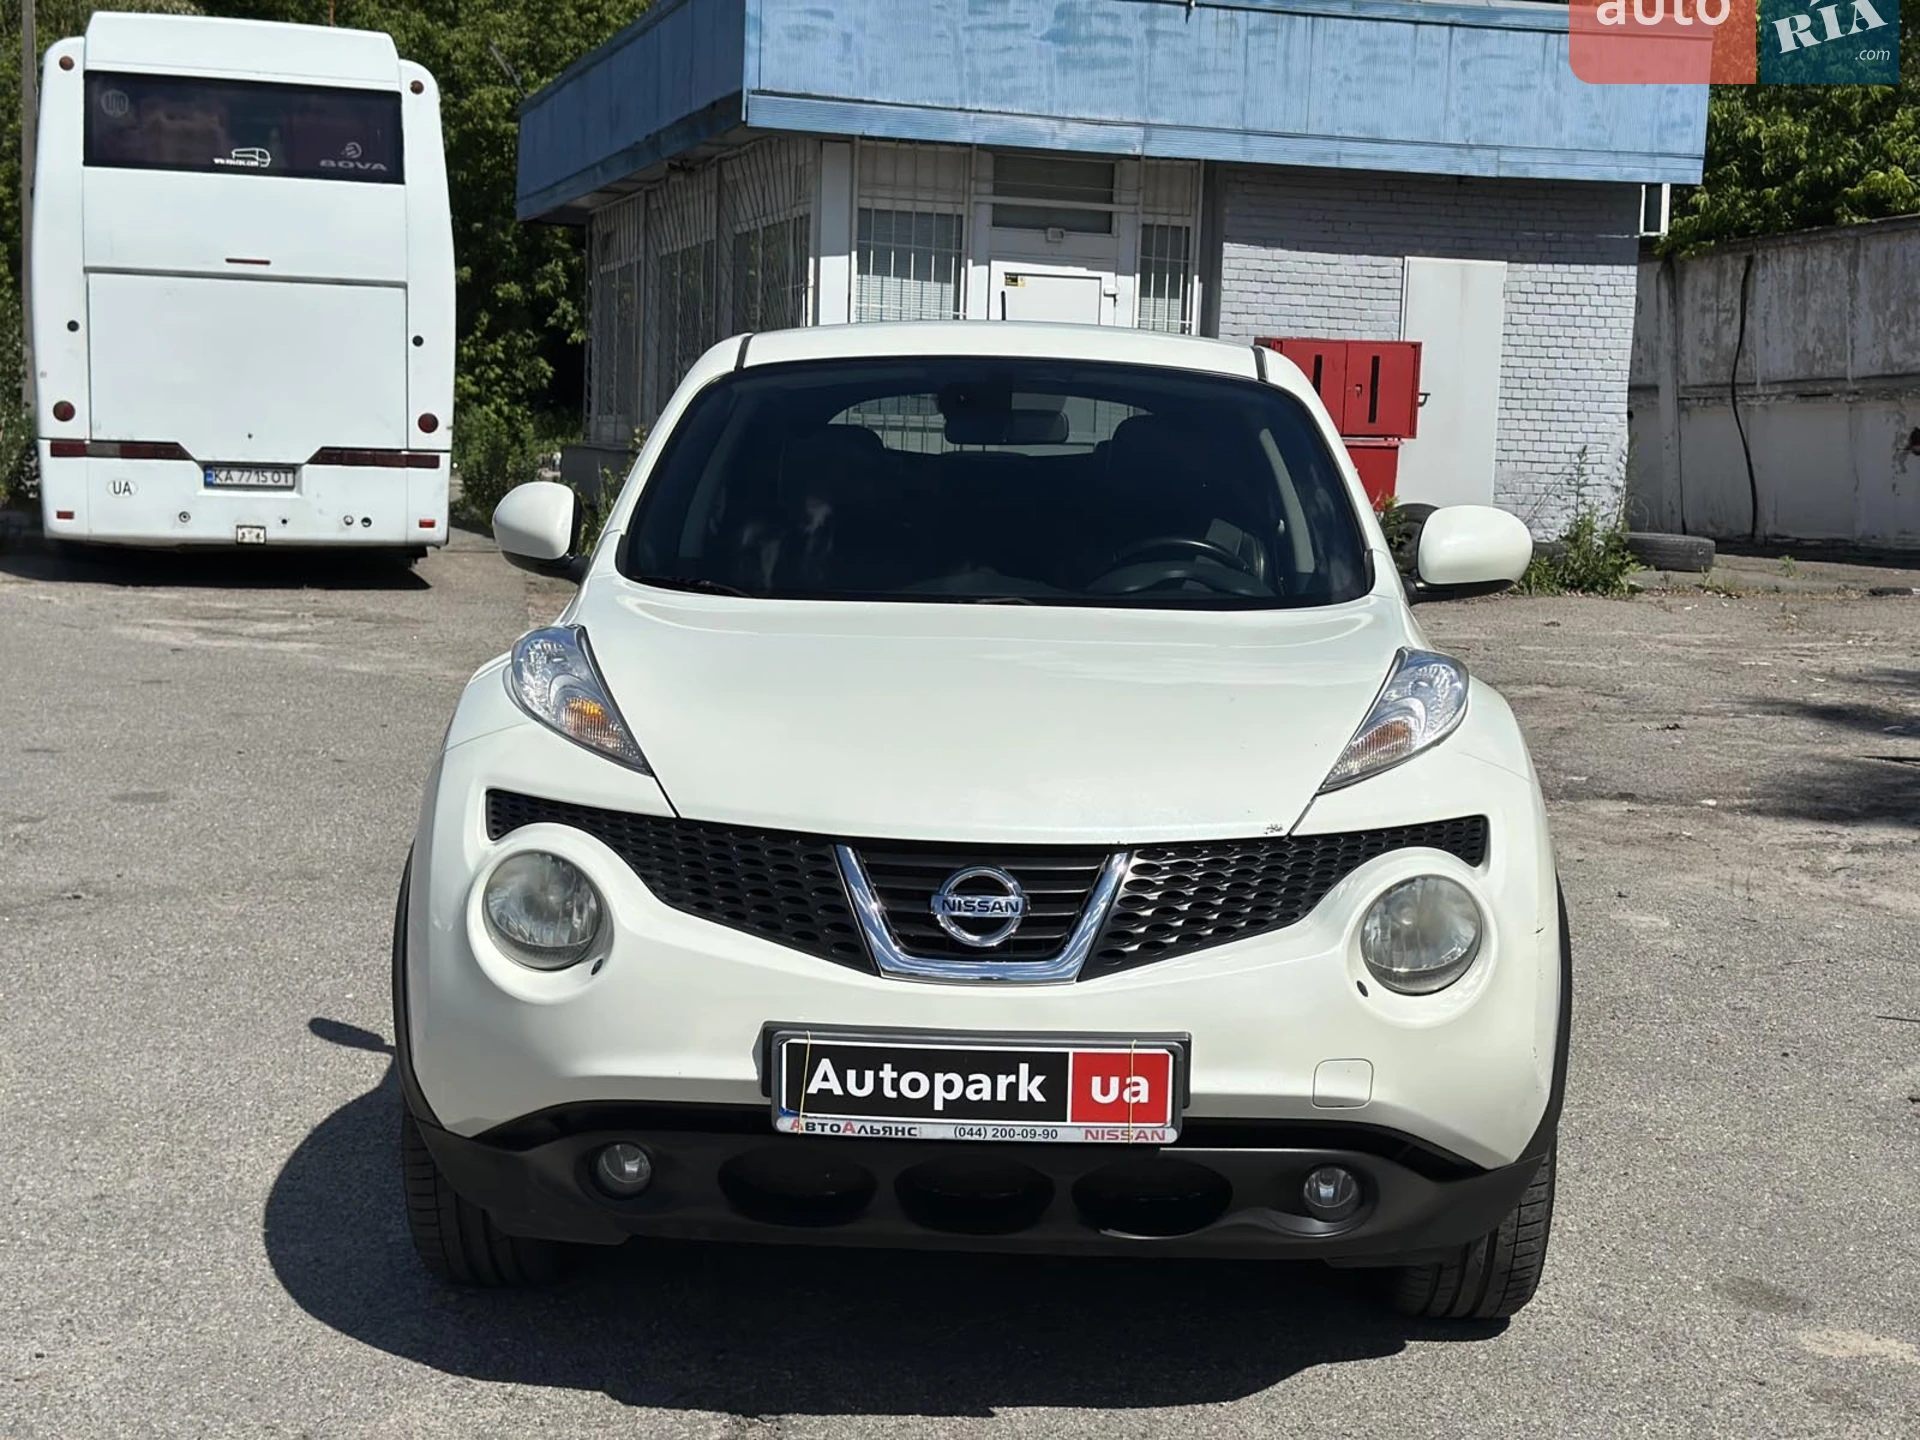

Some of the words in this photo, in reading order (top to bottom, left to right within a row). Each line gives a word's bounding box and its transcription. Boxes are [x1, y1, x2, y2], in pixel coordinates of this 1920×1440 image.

[319, 159, 388, 171] BOVA
[239, 469, 268, 483] 7715
[112, 480, 132, 495] UA
[941, 899, 1020, 913] NISSAN
[806, 1057, 1047, 1111] Autopark
[1091, 1074, 1149, 1104] ua
[953, 1126, 988, 1139] (044)
[991, 1127, 1058, 1140] 200-09-90
[1084, 1129, 1166, 1142] NISSAN
